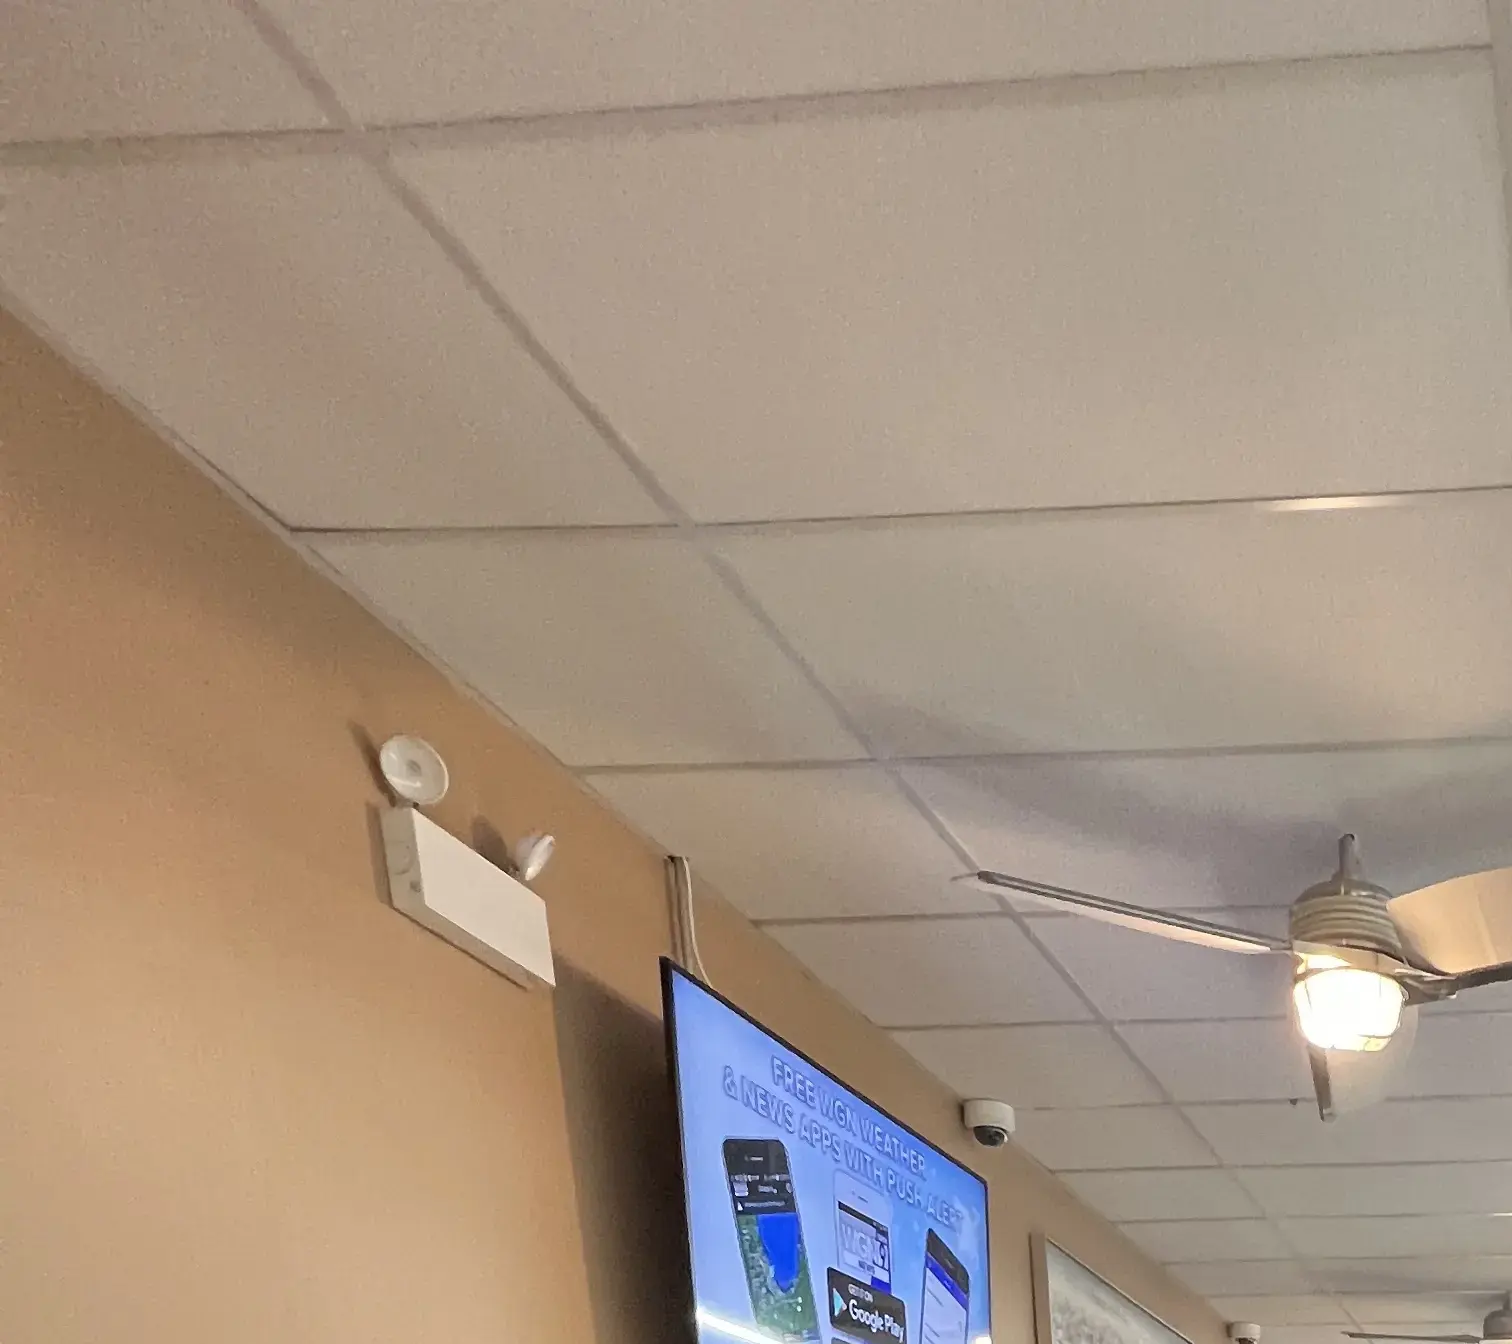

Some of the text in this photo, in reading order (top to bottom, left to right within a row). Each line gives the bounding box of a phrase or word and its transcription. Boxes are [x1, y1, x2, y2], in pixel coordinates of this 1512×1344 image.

[723, 1065, 738, 1101] &
[741, 1076, 796, 1134] NEWS
[799, 1113, 842, 1163] APPS
[843, 1142, 885, 1189] WITH
[886, 1169, 924, 1210] PUSH
[771, 1054, 928, 1182] FREE WGN WEATHER
[848, 1299, 904, 1344] Google Play
